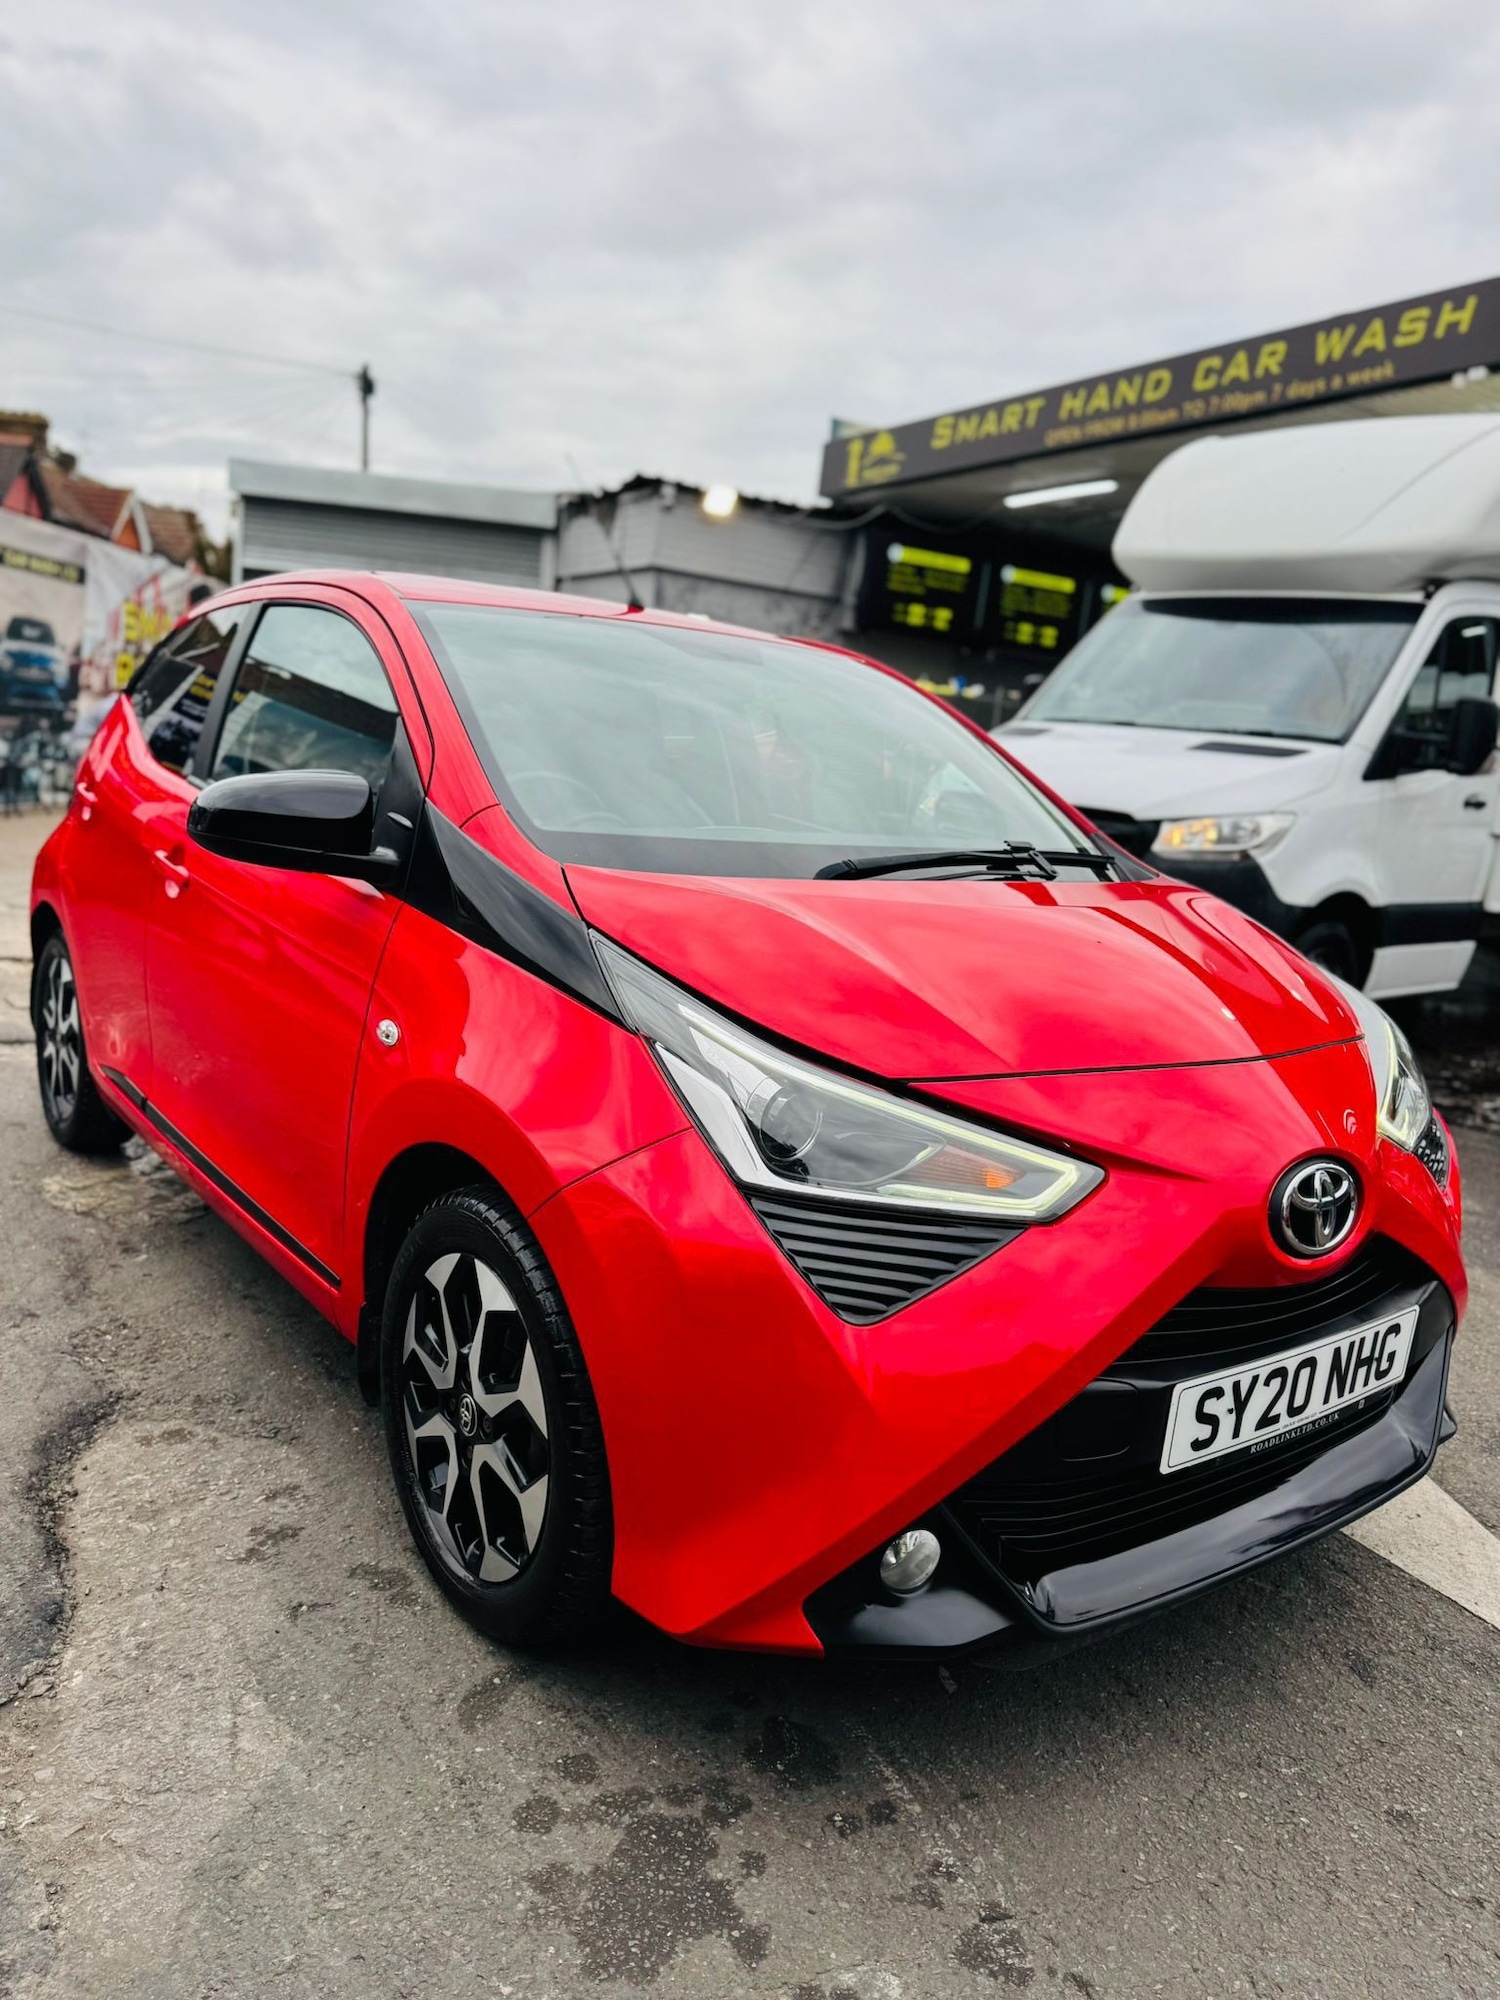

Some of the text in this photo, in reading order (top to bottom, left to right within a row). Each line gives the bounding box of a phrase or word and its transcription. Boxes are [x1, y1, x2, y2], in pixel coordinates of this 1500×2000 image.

[932, 296, 1477, 449] SMART HAND CAR WASH
[1183, 399, 1206, 419] TO
[1286, 377, 1327, 401] days
[1331, 374, 1342, 390] a
[1347, 361, 1396, 387] week
[1191, 1322, 1402, 1453] SY20 NHG
[1249, 1411, 1340, 1454] ROADLINKLTD.CO.UK
